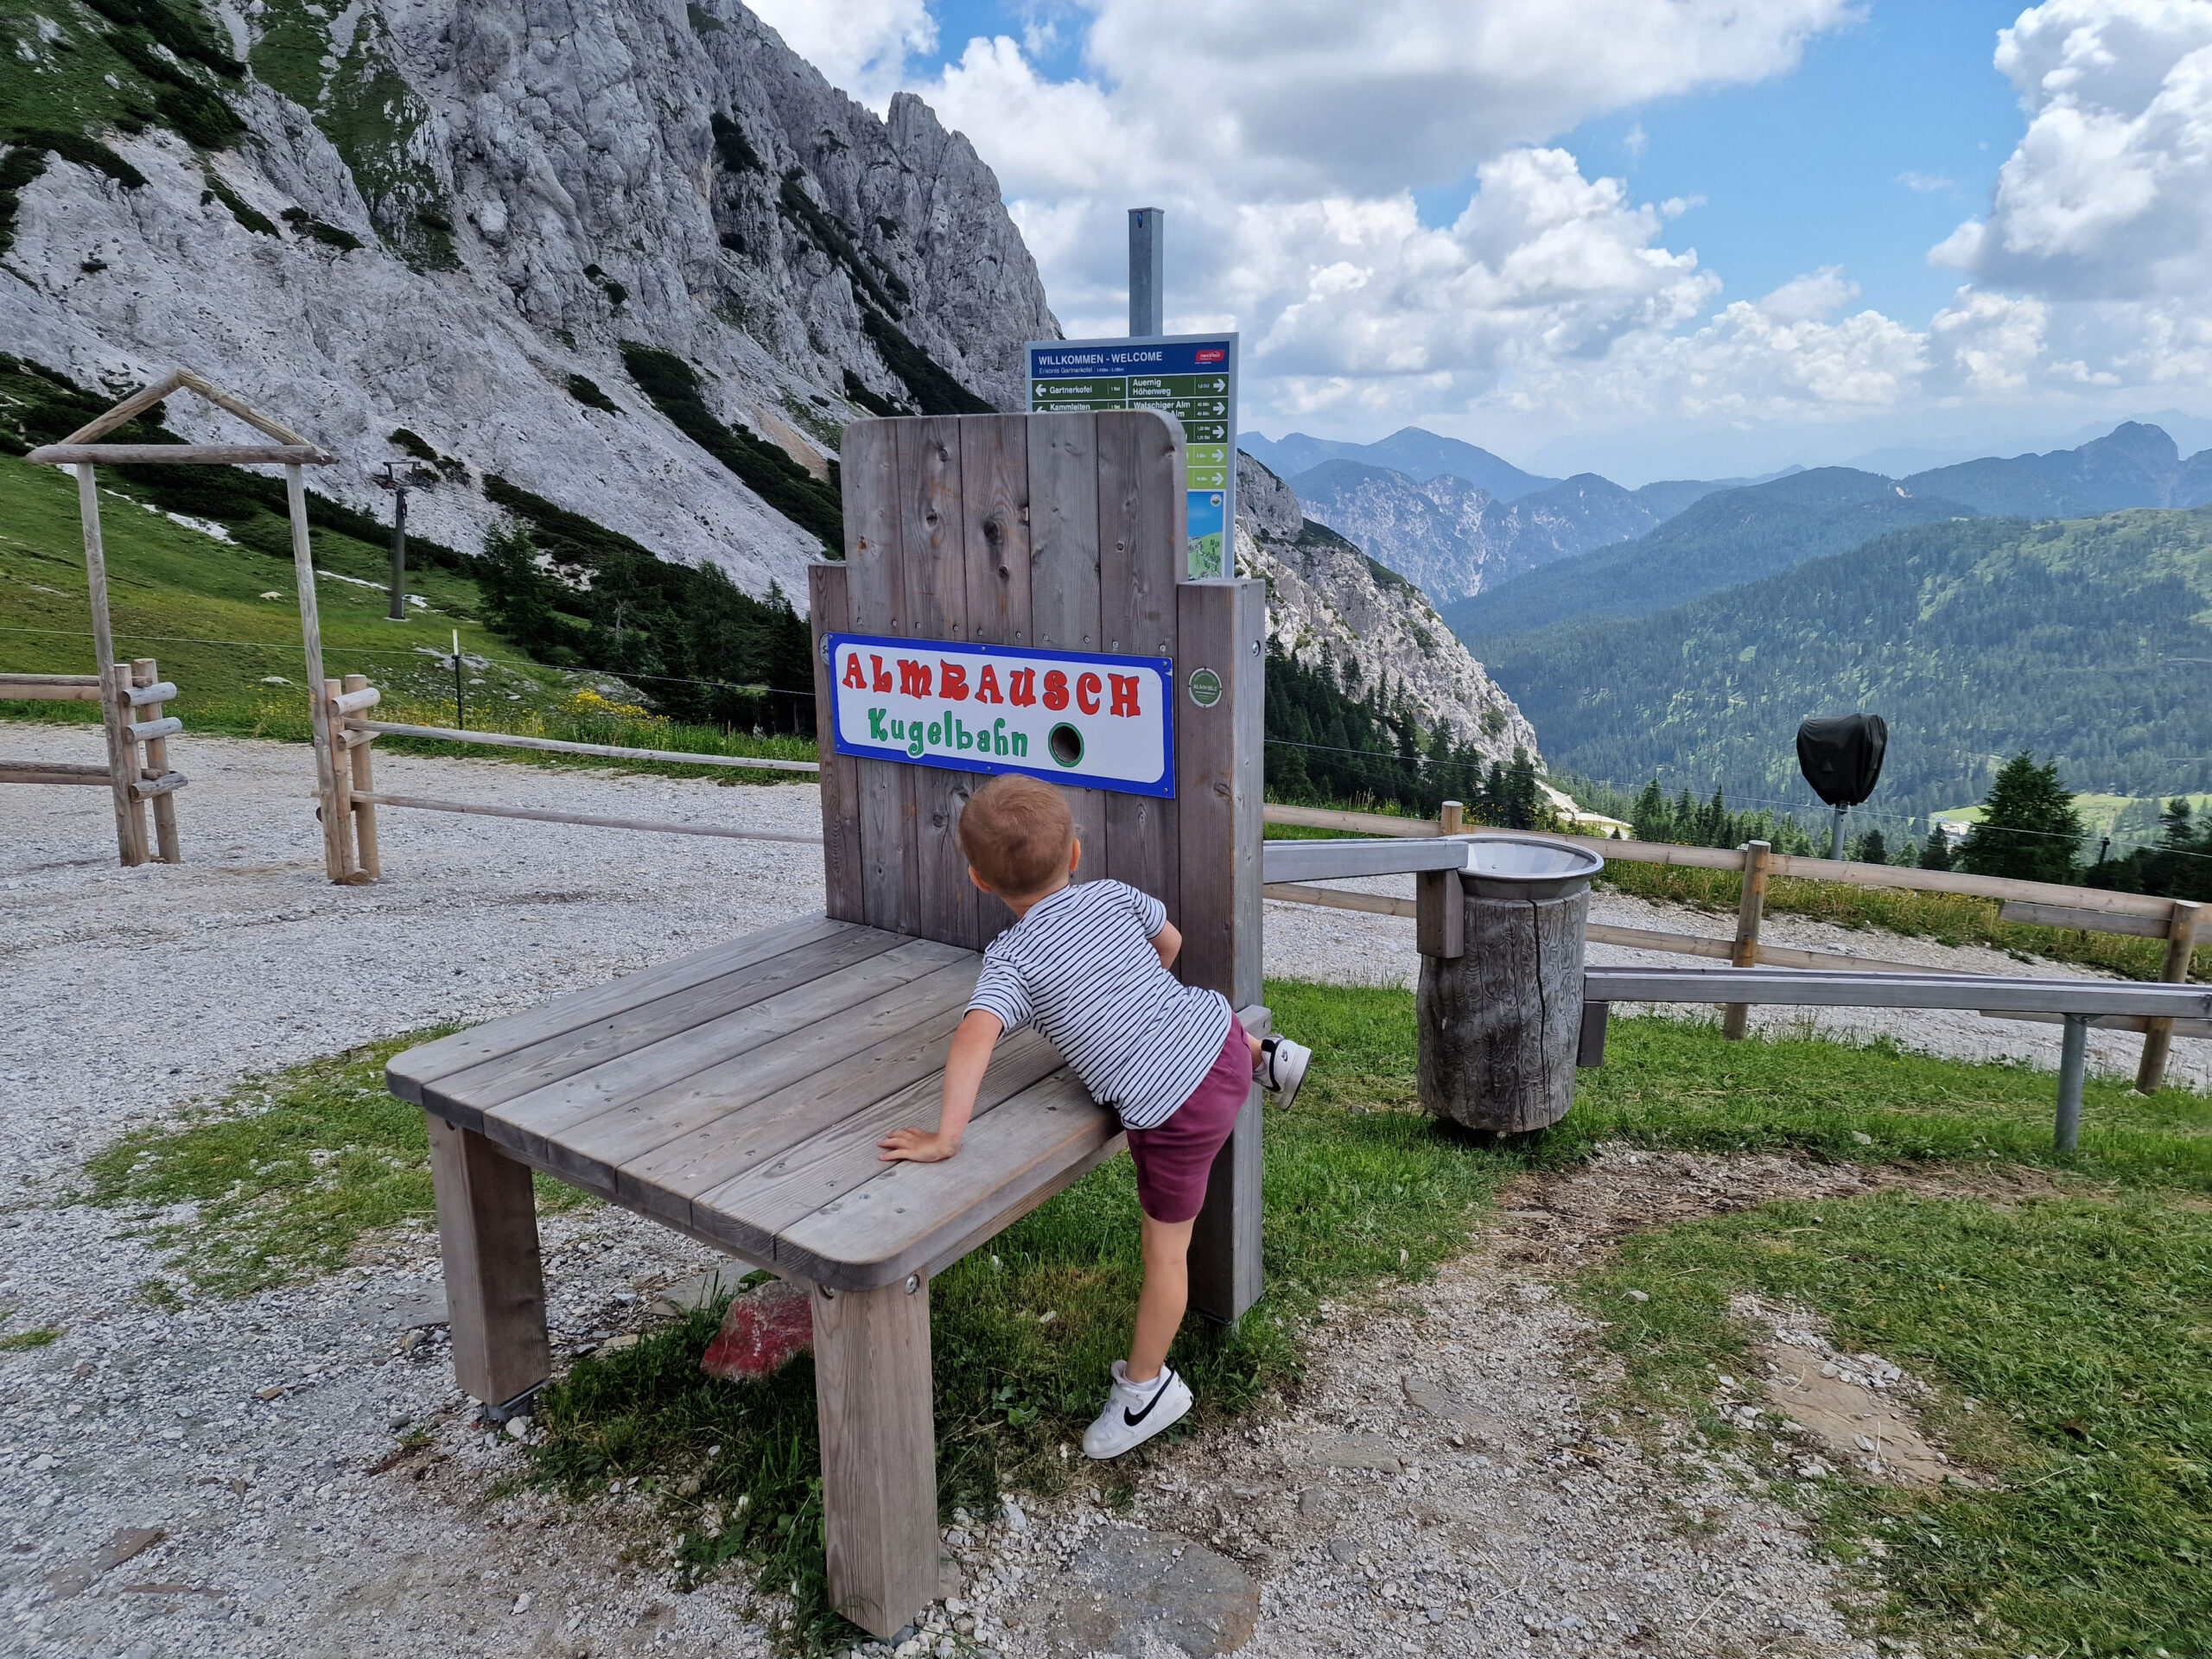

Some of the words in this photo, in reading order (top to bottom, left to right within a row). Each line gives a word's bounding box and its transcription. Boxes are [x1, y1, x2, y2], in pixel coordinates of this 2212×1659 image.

[1038, 354, 1103, 365] WILLKOMMEN
[1111, 352, 1162, 364] WELCOME
[1060, 365, 1093, 374] Gartnerkofel
[1133, 378, 1161, 387] Auernig
[1050, 385, 1092, 394] Gartnerkofel
[1133, 387, 1171, 397] Höhenweg
[1050, 403, 1090, 411] Kammleiten
[1134, 401, 1174, 410] Watschiger
[1176, 400, 1191, 409] Alm
[842, 652, 1141, 718] ALMRAUSCH
[868, 707, 1028, 757] Kugelbahn
